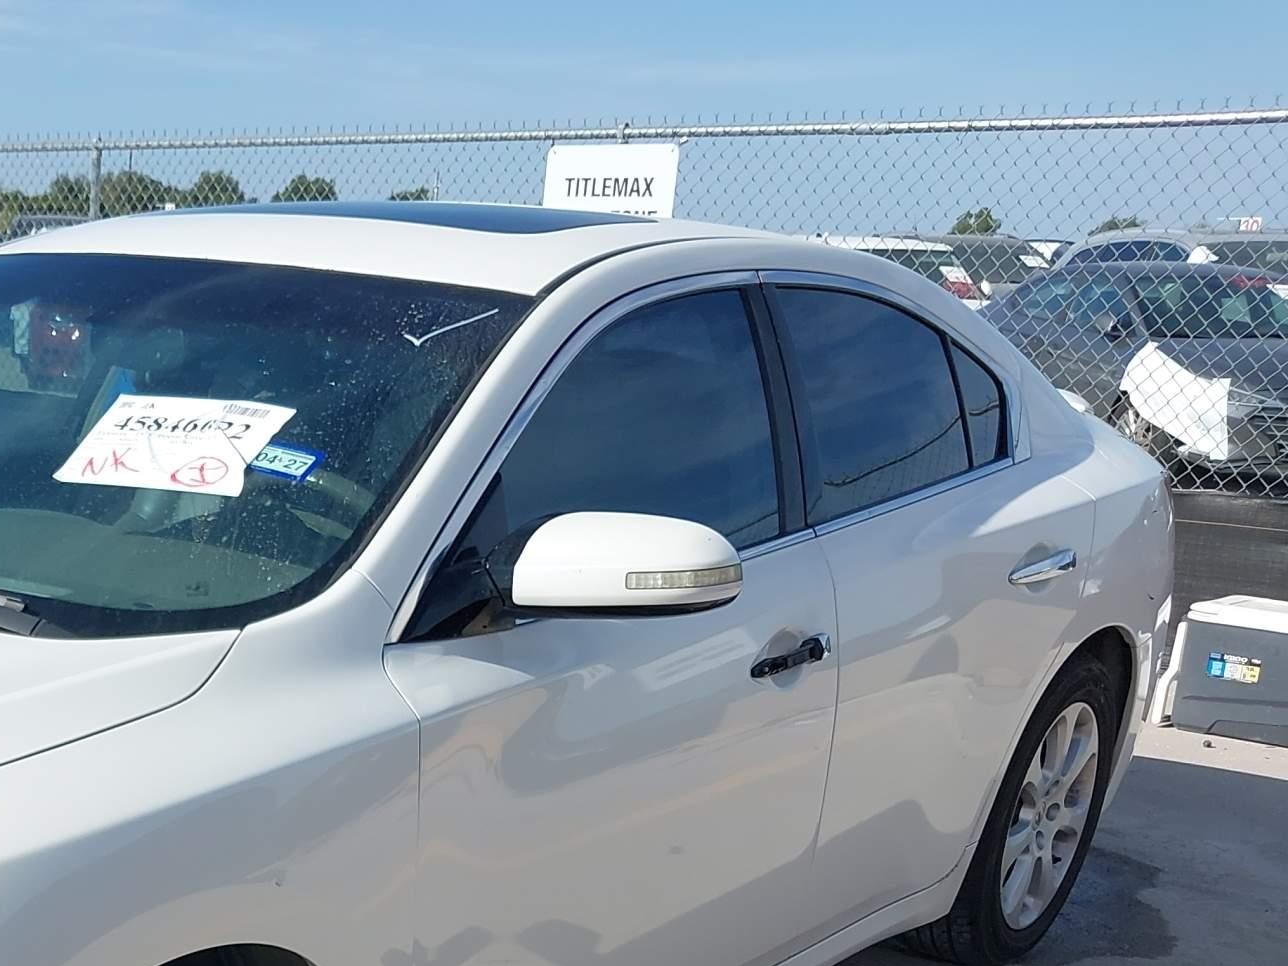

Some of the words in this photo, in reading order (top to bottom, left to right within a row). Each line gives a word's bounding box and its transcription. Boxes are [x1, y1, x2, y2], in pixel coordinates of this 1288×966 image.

[564, 176, 654, 198] TITLEMAX
[81, 447, 139, 477] NK
[283, 459, 309, 471] 27
